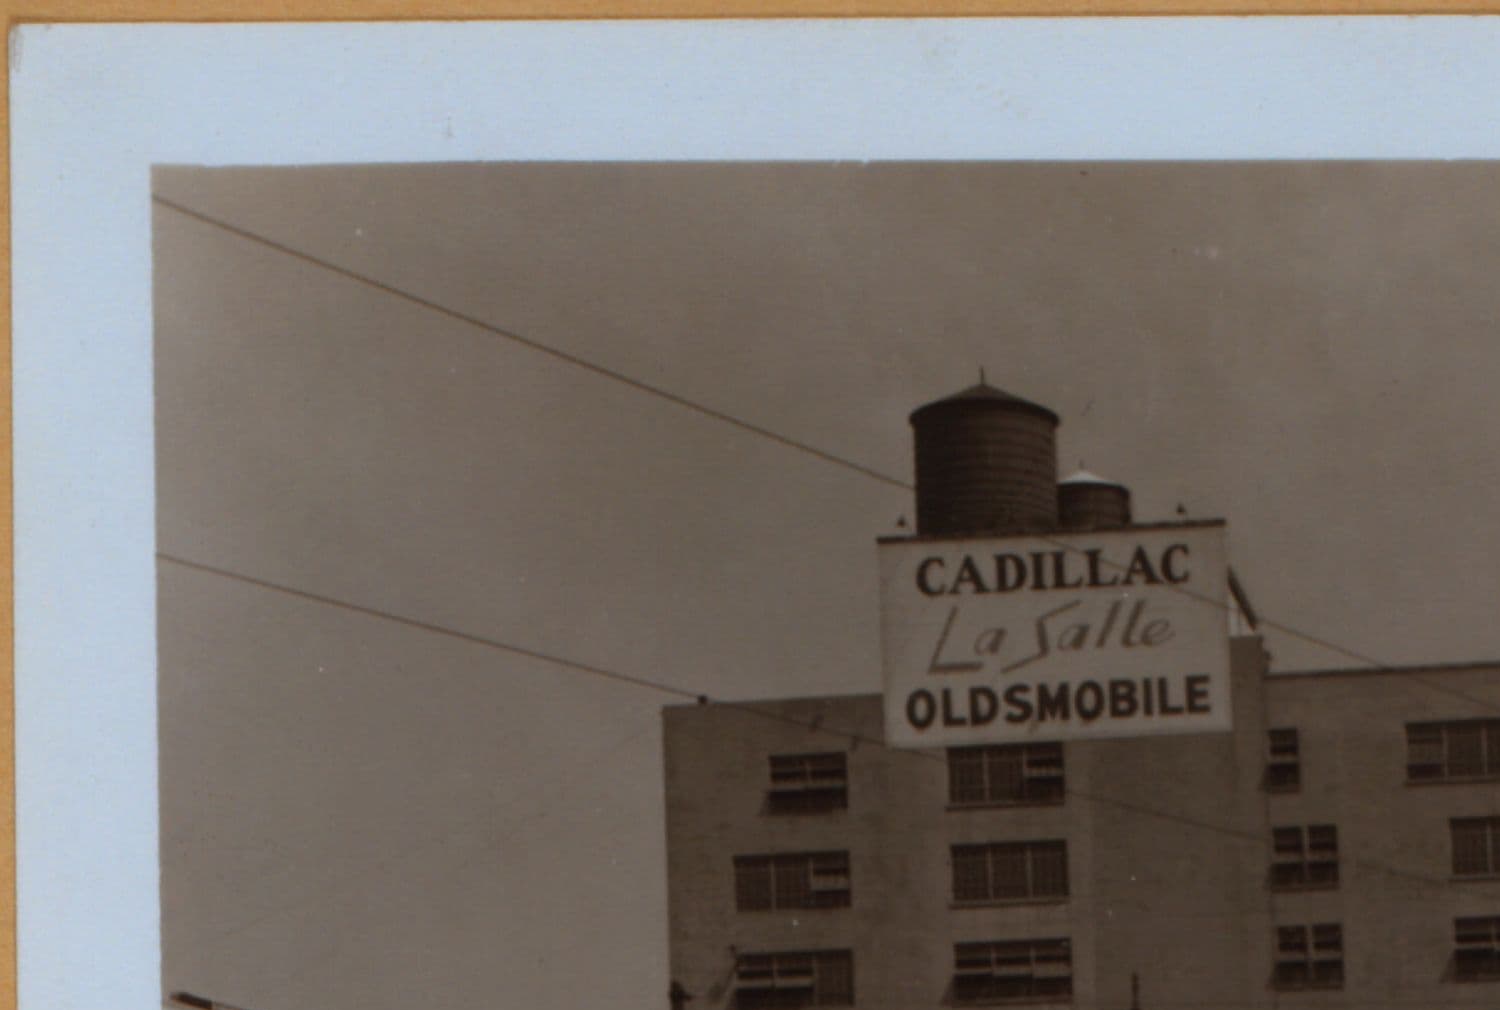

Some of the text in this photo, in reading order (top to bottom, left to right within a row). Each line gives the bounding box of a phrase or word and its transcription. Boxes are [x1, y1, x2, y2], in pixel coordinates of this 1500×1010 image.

[916, 544, 1190, 597] CADILLAC
[928, 600, 1175, 673] La Salle
[906, 674, 1211, 729] OLDSMOBILE
